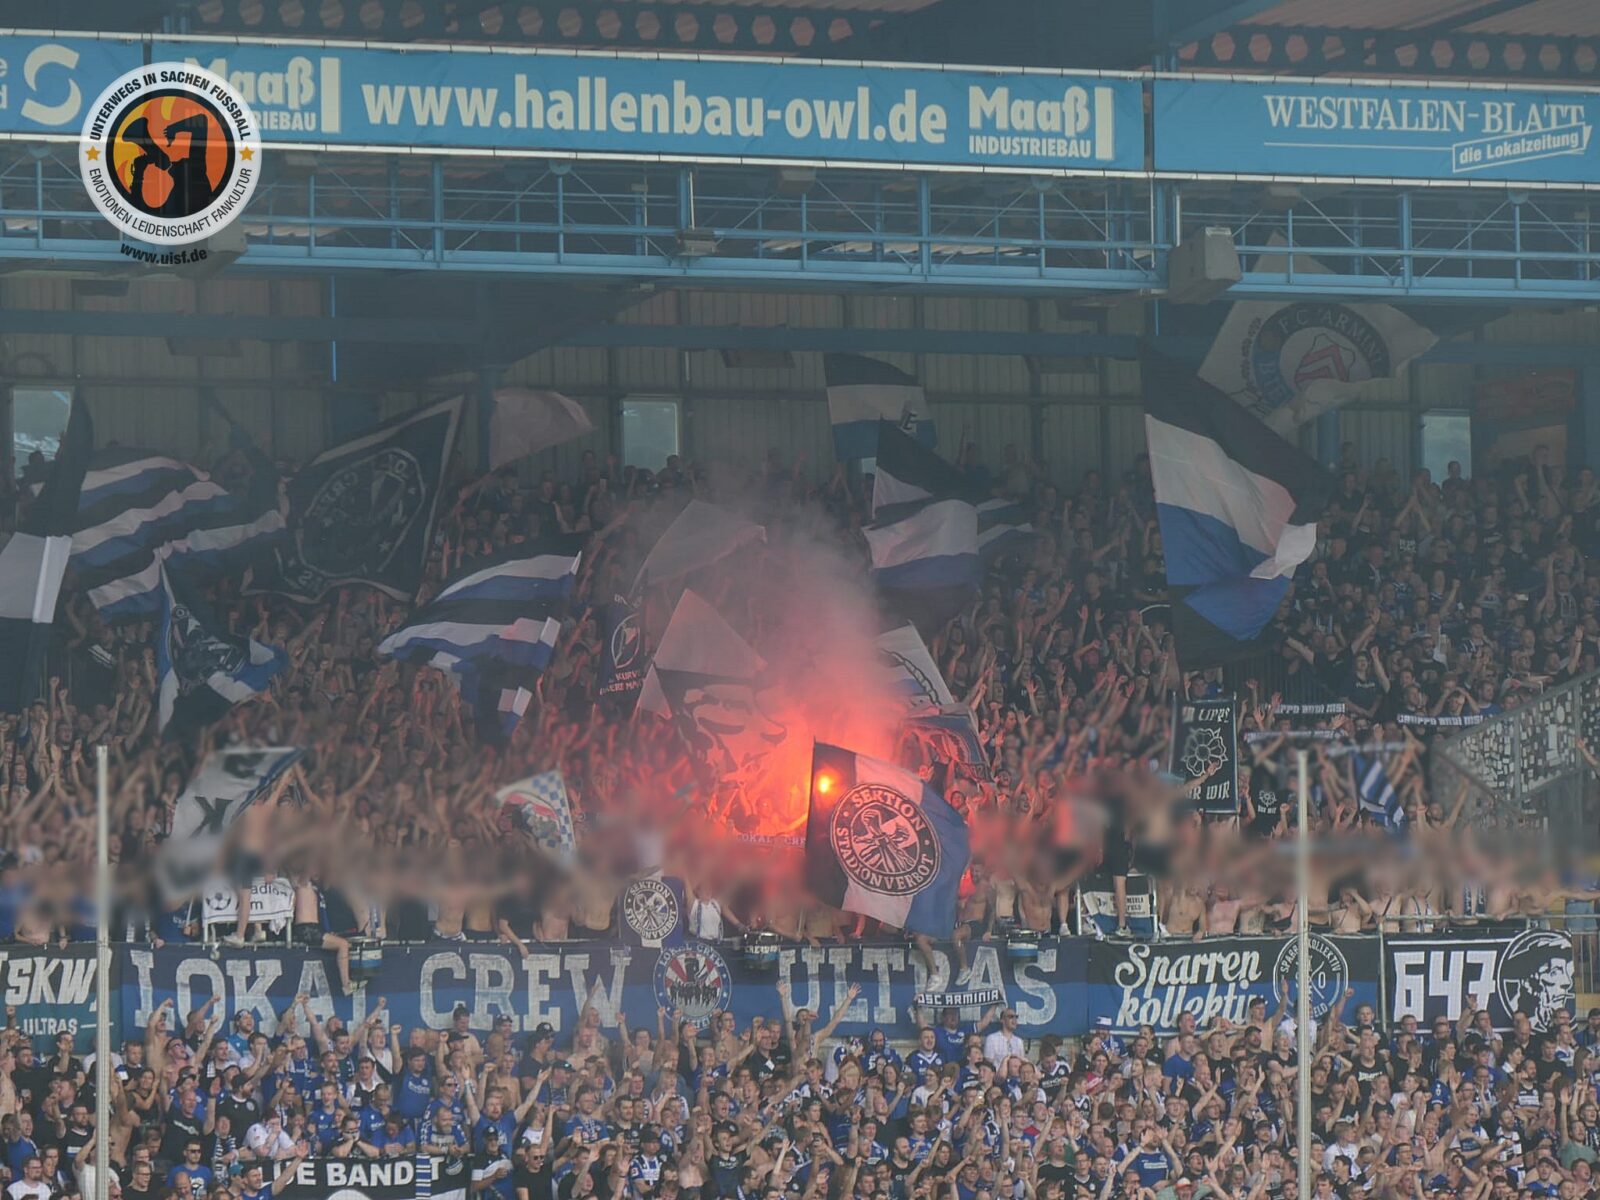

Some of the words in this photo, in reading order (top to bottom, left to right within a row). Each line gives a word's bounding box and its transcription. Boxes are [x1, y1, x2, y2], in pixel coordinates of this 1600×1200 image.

[361, 73, 947, 143] www.hallenbau-owl.de
[968, 85, 1090, 137] Maaß
[1263, 95, 1585, 134] WESTFALEN-BLATT
[968, 135, 1092, 158] INDUSTRIEBAU
[1459, 147, 1482, 164] die
[1486, 131, 1580, 160] Lokalzeitung
[852, 789, 926, 832] SEKTION
[836, 827, 934, 890] STADIONVERBOT
[629, 880, 671, 898] SEKTION
[130, 949, 390, 1038] LOKAL
[419, 947, 632, 1032] CREW
[777, 945, 1058, 1026] ULTRAS
[1114, 943, 1263, 999] Sparren
[1393, 950, 1498, 1023] 647
[945, 989, 1001, 1005] ARMINIA
[23, 1017, 79, 1036] ULTRAS
[326, 1157, 445, 1187] BANDT
